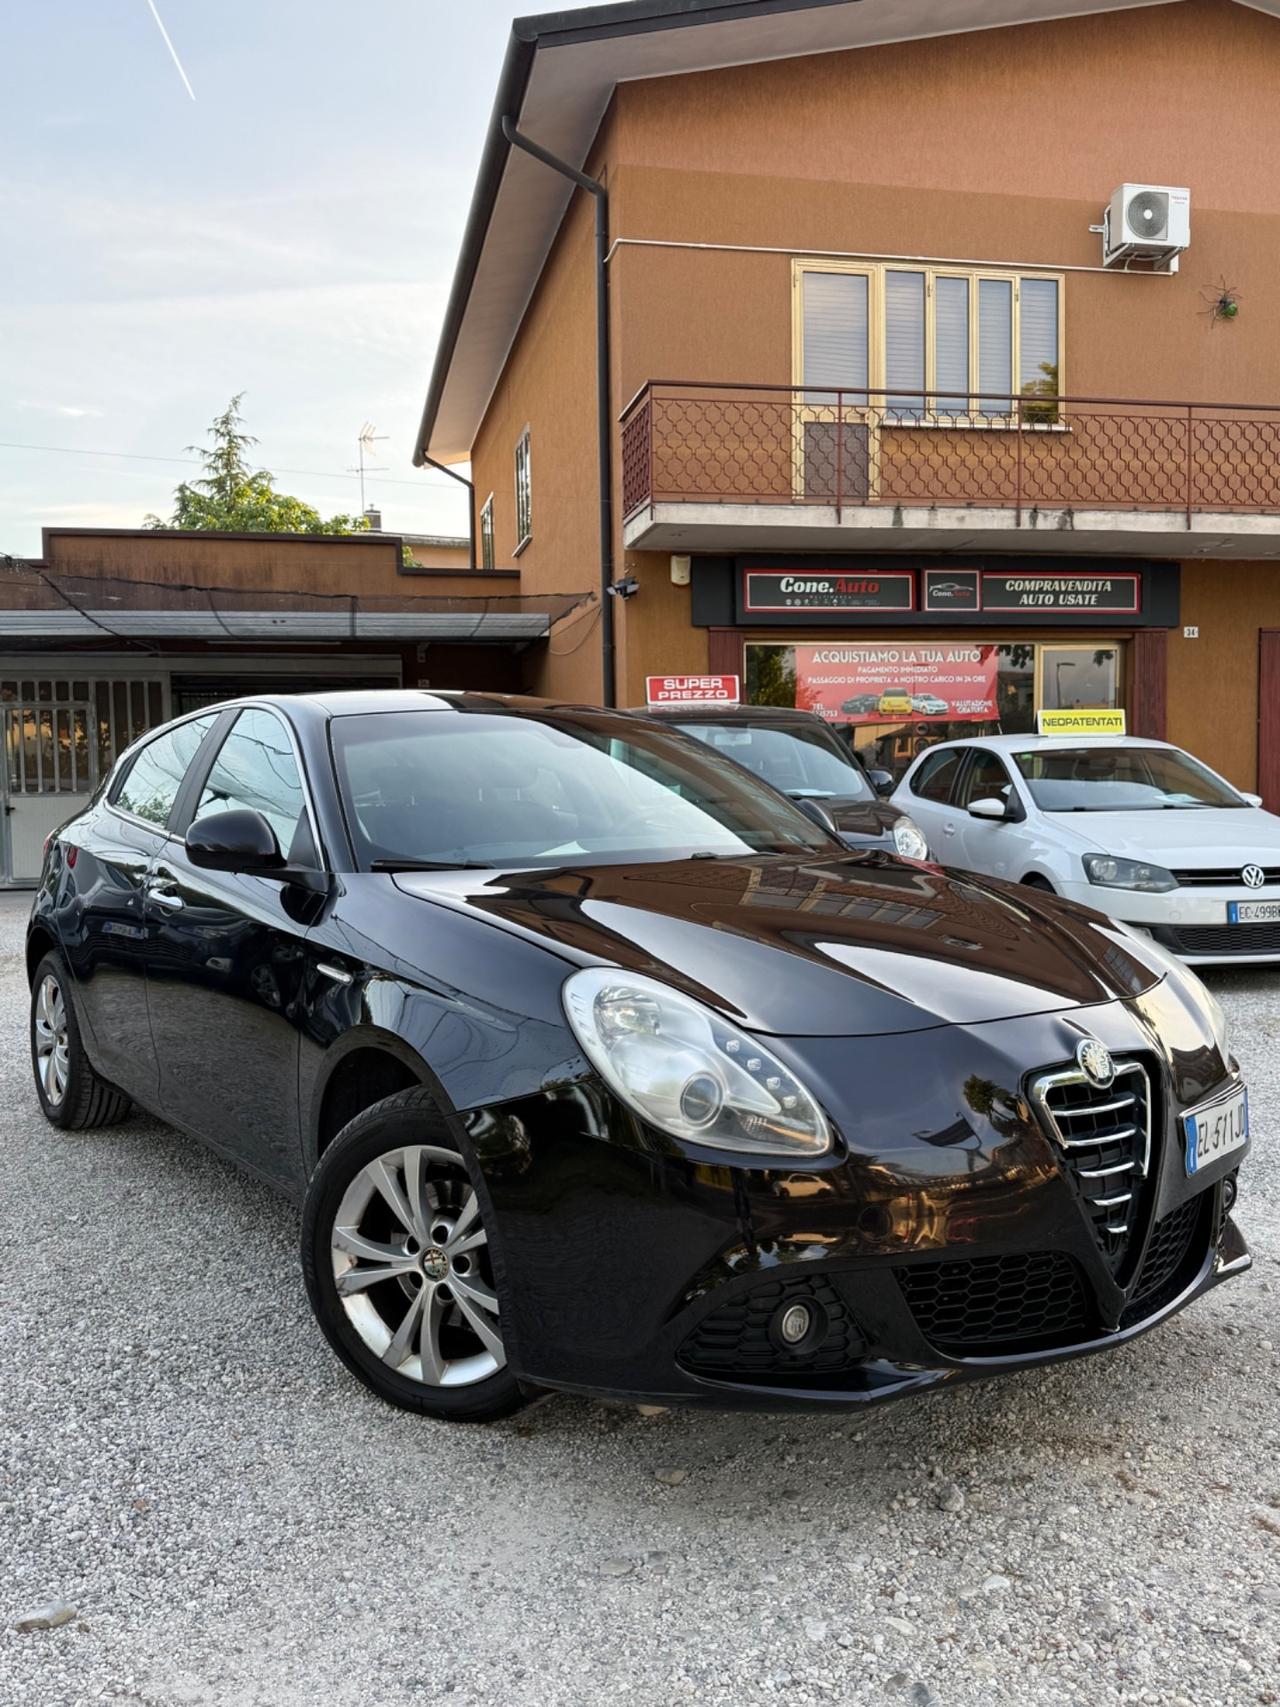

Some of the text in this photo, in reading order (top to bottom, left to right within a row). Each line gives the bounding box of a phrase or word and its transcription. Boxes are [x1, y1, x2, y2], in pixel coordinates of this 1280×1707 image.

[780, 577, 880, 593] Cone.Auto
[1005, 580, 1112, 592] COMPRAVENDITA
[1019, 594, 1099, 605] AUTO USATE
[812, 650, 981, 663] ACQUISTIAMO LA TUA AUTO
[663, 679, 723, 690] SUPER
[808, 676, 846, 684] PASSAGGIO
[847, 676, 855, 684] DI
[900, 675, 929, 683] NOSTRO
[930, 675, 955, 683] CARICO
[973, 675, 987, 683] ORE
[658, 690, 728, 700] PREZZO
[1042, 717, 1122, 727] NEOPATENTATI
